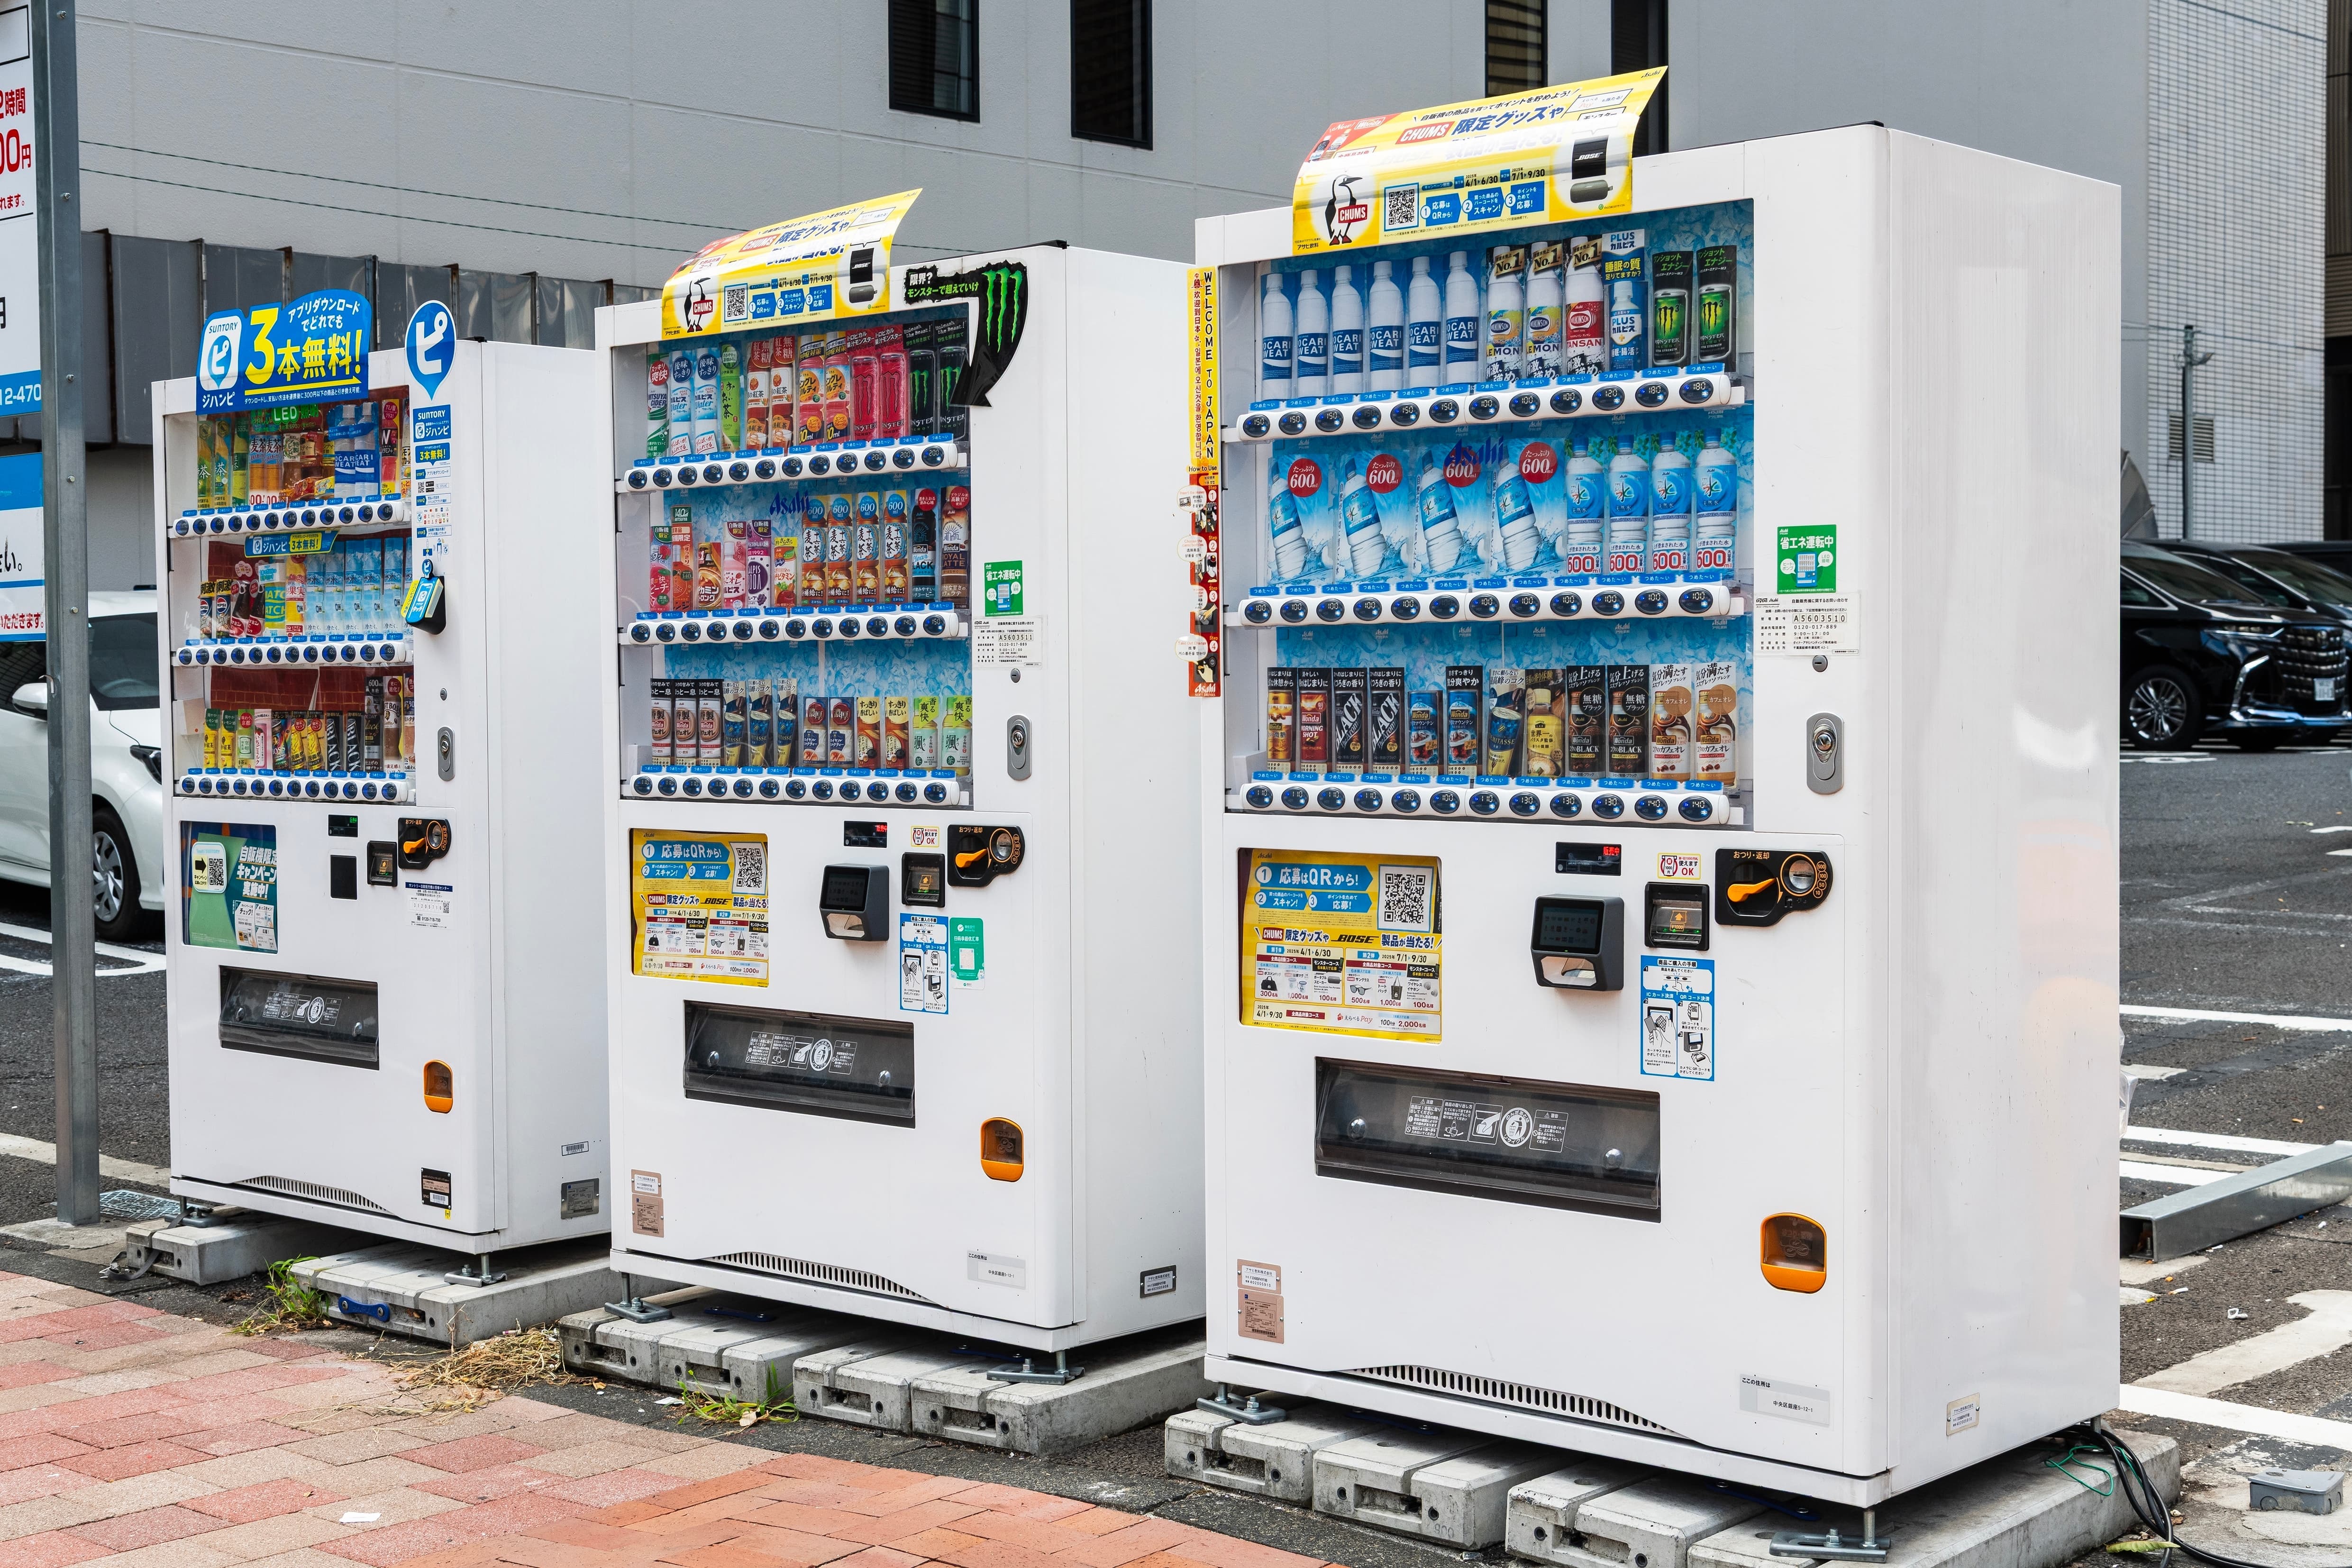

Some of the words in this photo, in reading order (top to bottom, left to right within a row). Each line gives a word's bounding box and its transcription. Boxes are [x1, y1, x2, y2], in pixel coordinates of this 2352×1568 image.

[1451, 104, 1564, 136] 限定グッズや
[1400, 124, 1449, 142] CHUMS
[1575, 152, 1604, 161] BOSE
[1512, 171, 1523, 181] 7/1
[1528, 170, 1545, 178] 9/30
[1465, 179, 1477, 187] 4/1
[1481, 176, 1498, 185] 6/30
[1474, 206, 1500, 215] スキャン!
[1517, 201, 1533, 209] 応募!
[1340, 208, 1367, 220] CHUMS
[775, 220, 850, 245] 限定グッズや
[1610, 232, 1635, 240] PLUS
[743, 236, 776, 250] CHUMS
[1611, 241, 1635, 250] カルピス
[1574, 241, 1600, 264] No.1
[1605, 258, 1641, 273] 睡眠の質
[1705, 257, 1732, 266] エナジー
[910, 273, 933, 286] 限界?
[1605, 271, 1641, 280] 足りてますか?
[908, 282, 979, 298] モンスターで超えていけ
[288, 298, 360, 323] アプリダウンロード
[694, 301, 712, 313] CHUMS
[1204, 272, 1212, 360] WELCOME
[209, 322, 238, 334] SUNTORY
[301, 315, 343, 332] でどれでも
[935, 320, 955, 330] Unleash
[847, 331, 867, 342] トロピカル
[847, 337, 874, 347] 果汁モンスター
[245, 307, 362, 385] 3本無料!
[416, 310, 450, 375] ピ
[775, 338, 782, 356] 紅茶
[783, 337, 793, 359] 無糖
[1567, 338, 1601, 347] TANSAN
[212, 340, 229, 375] ピ
[675, 361, 688, 369] 後味
[651, 370, 668, 381] 爽快
[674, 368, 690, 378] すっきり
[1207, 369, 1212, 388] TO
[202, 392, 235, 408] ジハンピ
[274, 406, 297, 421] LED
[418, 410, 446, 419] SUNTORY
[426, 426, 449, 437] ジハンピ
[420, 451, 446, 461] 3本無料!
[1444, 435, 1504, 467] Asahi
[1372, 461, 1395, 469] たっぷり
[1290, 474, 1318, 489] 600ml
[1368, 469, 1398, 484] 600ml
[769, 490, 810, 515] Asahi
[833, 505, 848, 514] 600
[263, 542, 287, 553] ジハンピ
[1780, 536, 1833, 549] 省エネ運転中
[986, 569, 1021, 581] 省エネ運転中
[288, 586, 305, 595] 果実
[1195, 684, 1215, 693] Asahi
[965, 697, 972, 712] 香る
[1583, 694, 1602, 704] 無糖
[954, 701, 964, 721] 爽快
[1413, 711, 1429, 720] Wonda
[347, 720, 361, 772] BLACK
[1603, 846, 1620, 856] 販売中
[1733, 851, 1770, 859] おつり・返却
[237, 863, 276, 882] キャンペーン
[667, 895, 700, 905] 限定グッズや
[752, 912, 765, 921] 9/30
[1381, 935, 1434, 948] 製品が当たる!
[1361, 1015, 1373, 1023] Pay
[1504, 1134, 1525, 1144] リサイクル
[1246, 1267, 1272, 1276] アサヒ飲料株式会社
[1742, 1377, 1770, 1388] ここの住所は
[1773, 1401, 1813, 1413] 中央区銀座5-12-1
